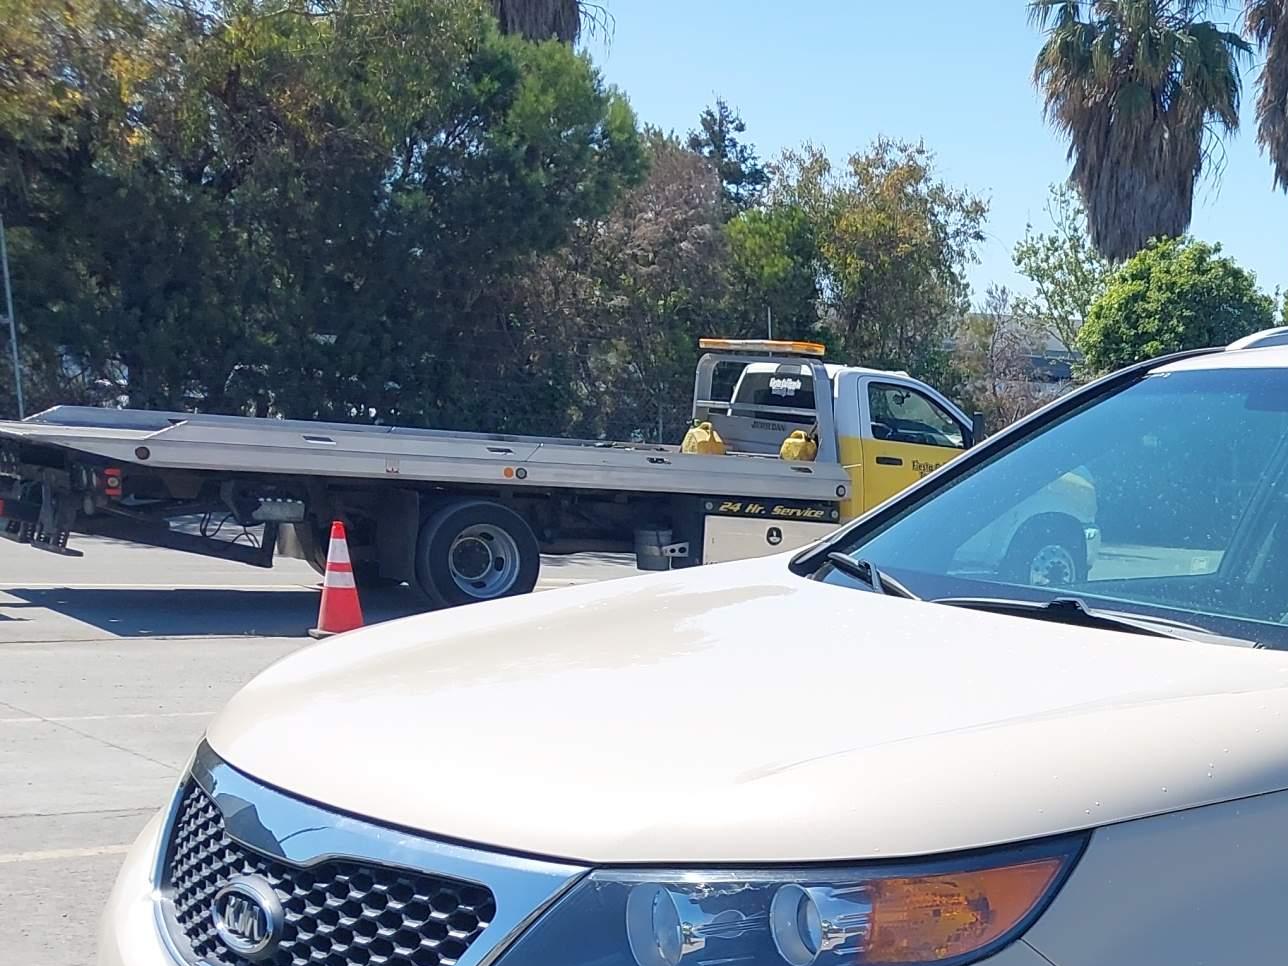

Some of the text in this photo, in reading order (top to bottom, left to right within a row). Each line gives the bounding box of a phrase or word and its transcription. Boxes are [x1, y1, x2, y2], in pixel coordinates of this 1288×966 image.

[718, 501, 825, 518] 24 Hr. Service
